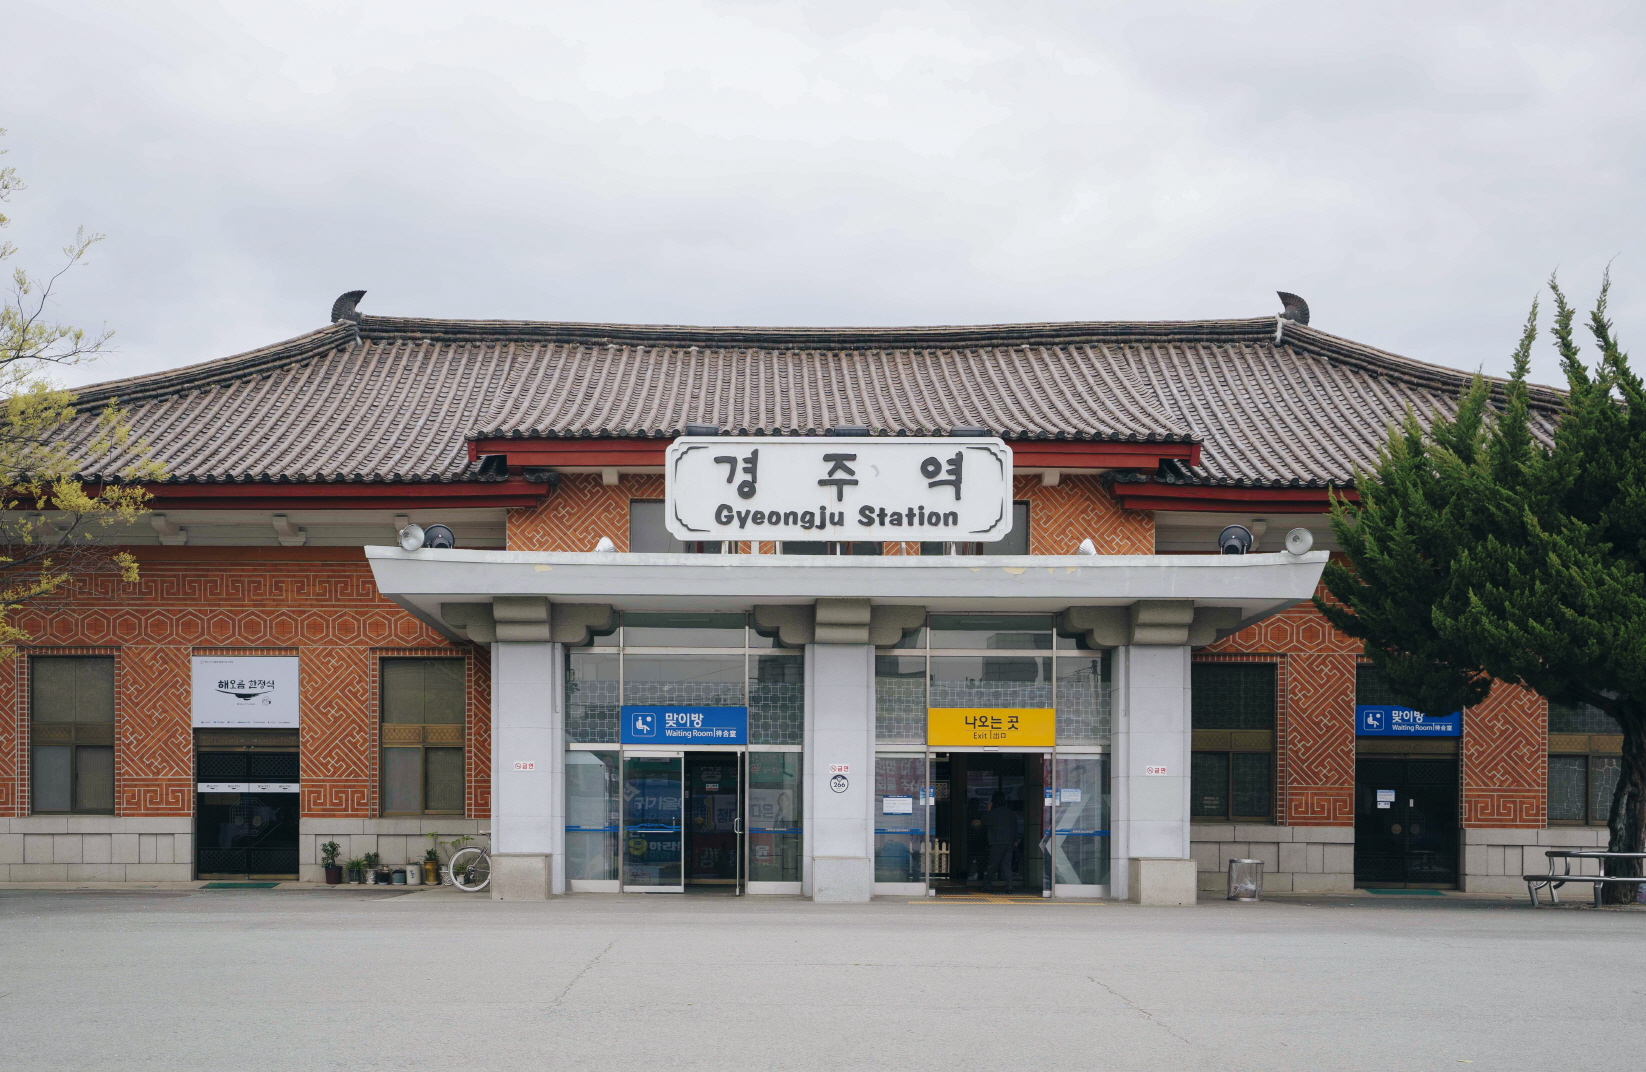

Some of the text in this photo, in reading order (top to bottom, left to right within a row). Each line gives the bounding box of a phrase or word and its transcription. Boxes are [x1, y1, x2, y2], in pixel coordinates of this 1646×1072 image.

[714, 503, 959, 531] Gyeongju Station
[217, 679, 275, 690] 해오름 한정식
[665, 712, 704, 728] 맞이방
[964, 714, 1020, 730] 나오는 곳
[1391, 710, 1425, 723] 맞이방
[1391, 724, 1415, 732] Waiting
[665, 729, 692, 739] Waiting
[973, 732, 987, 740] Exit
[993, 732, 1007, 740] 出口
